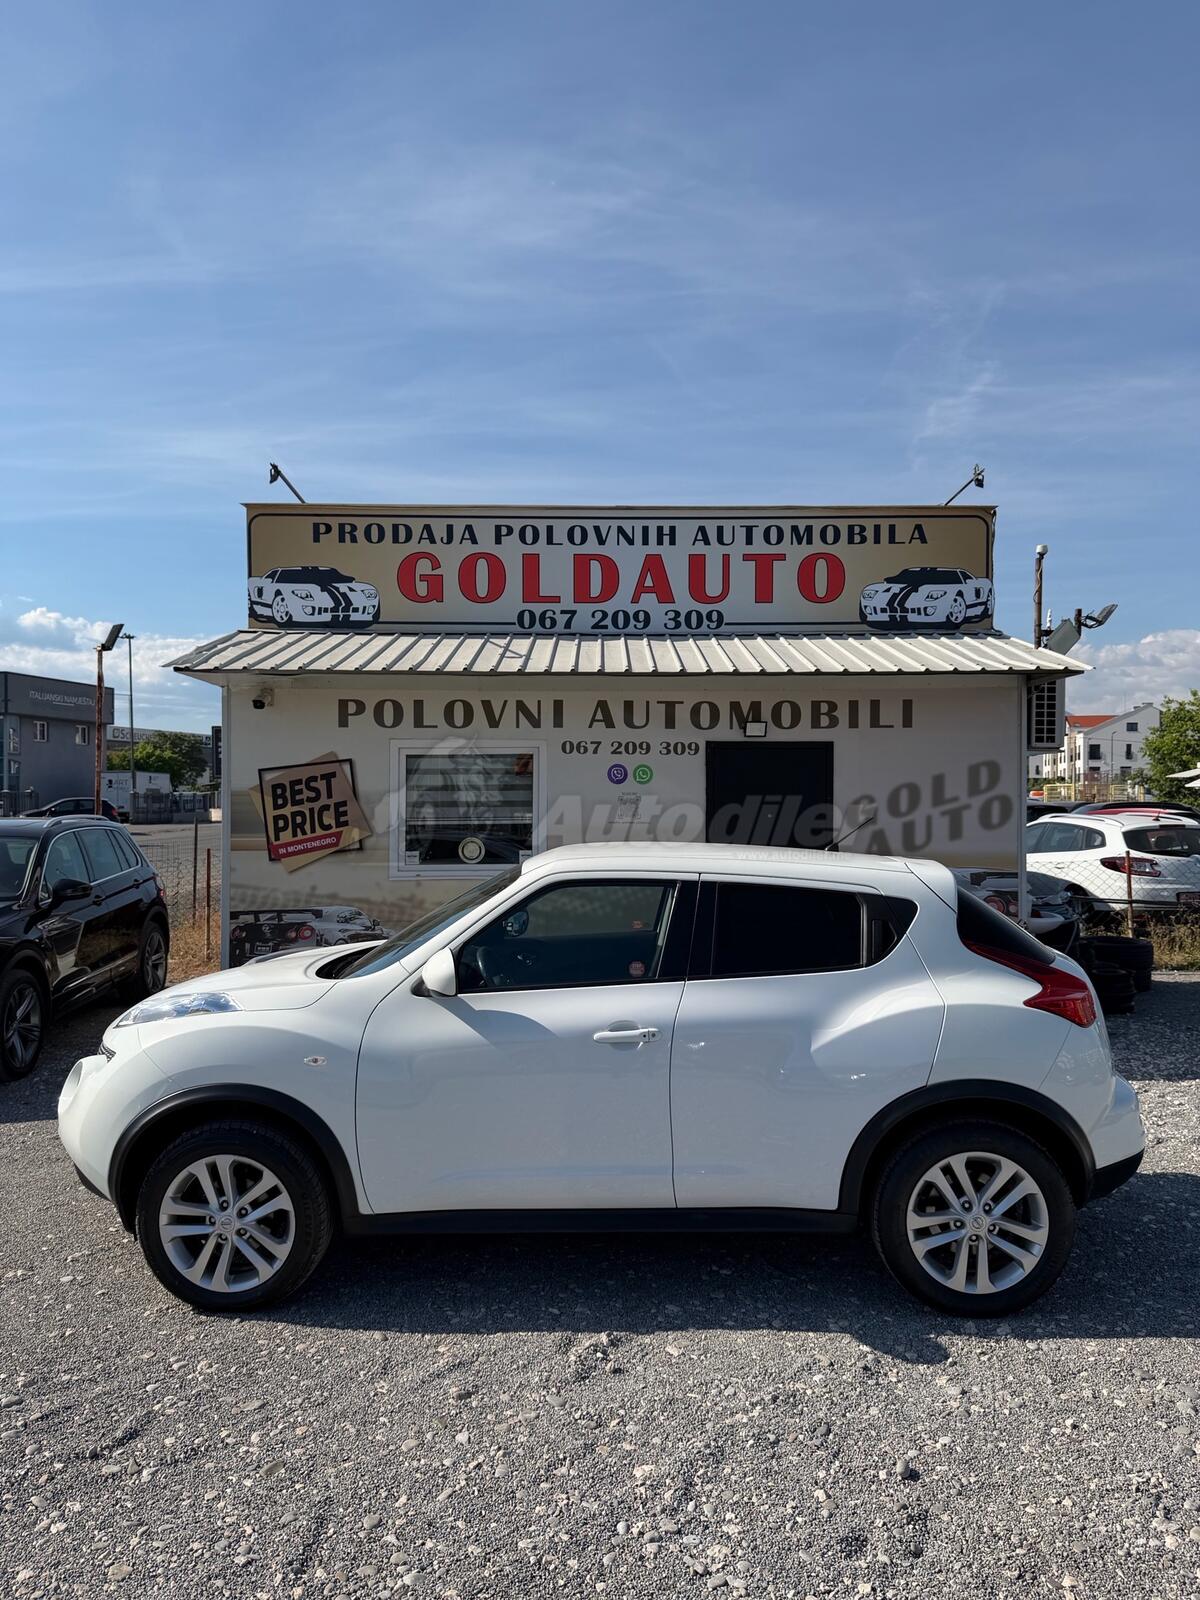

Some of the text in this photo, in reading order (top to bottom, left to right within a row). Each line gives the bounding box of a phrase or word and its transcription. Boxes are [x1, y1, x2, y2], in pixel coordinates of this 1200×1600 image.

[312, 522, 928, 546] PRODAJA POLOVNIH AUTOMOBILA
[396, 551, 846, 604] GOLDAUTO
[517, 609, 725, 631] 067 209 309
[338, 699, 913, 730] POLOVNI AUTOMOBILI
[561, 740, 700, 756] 067 209 309
[271, 771, 337, 811] BEST
[846, 760, 1002, 827] GOLD
[272, 800, 349, 842] PRICE
[865, 794, 1013, 856] AUTO
[287, 837, 337, 853] MONTENEGRO
